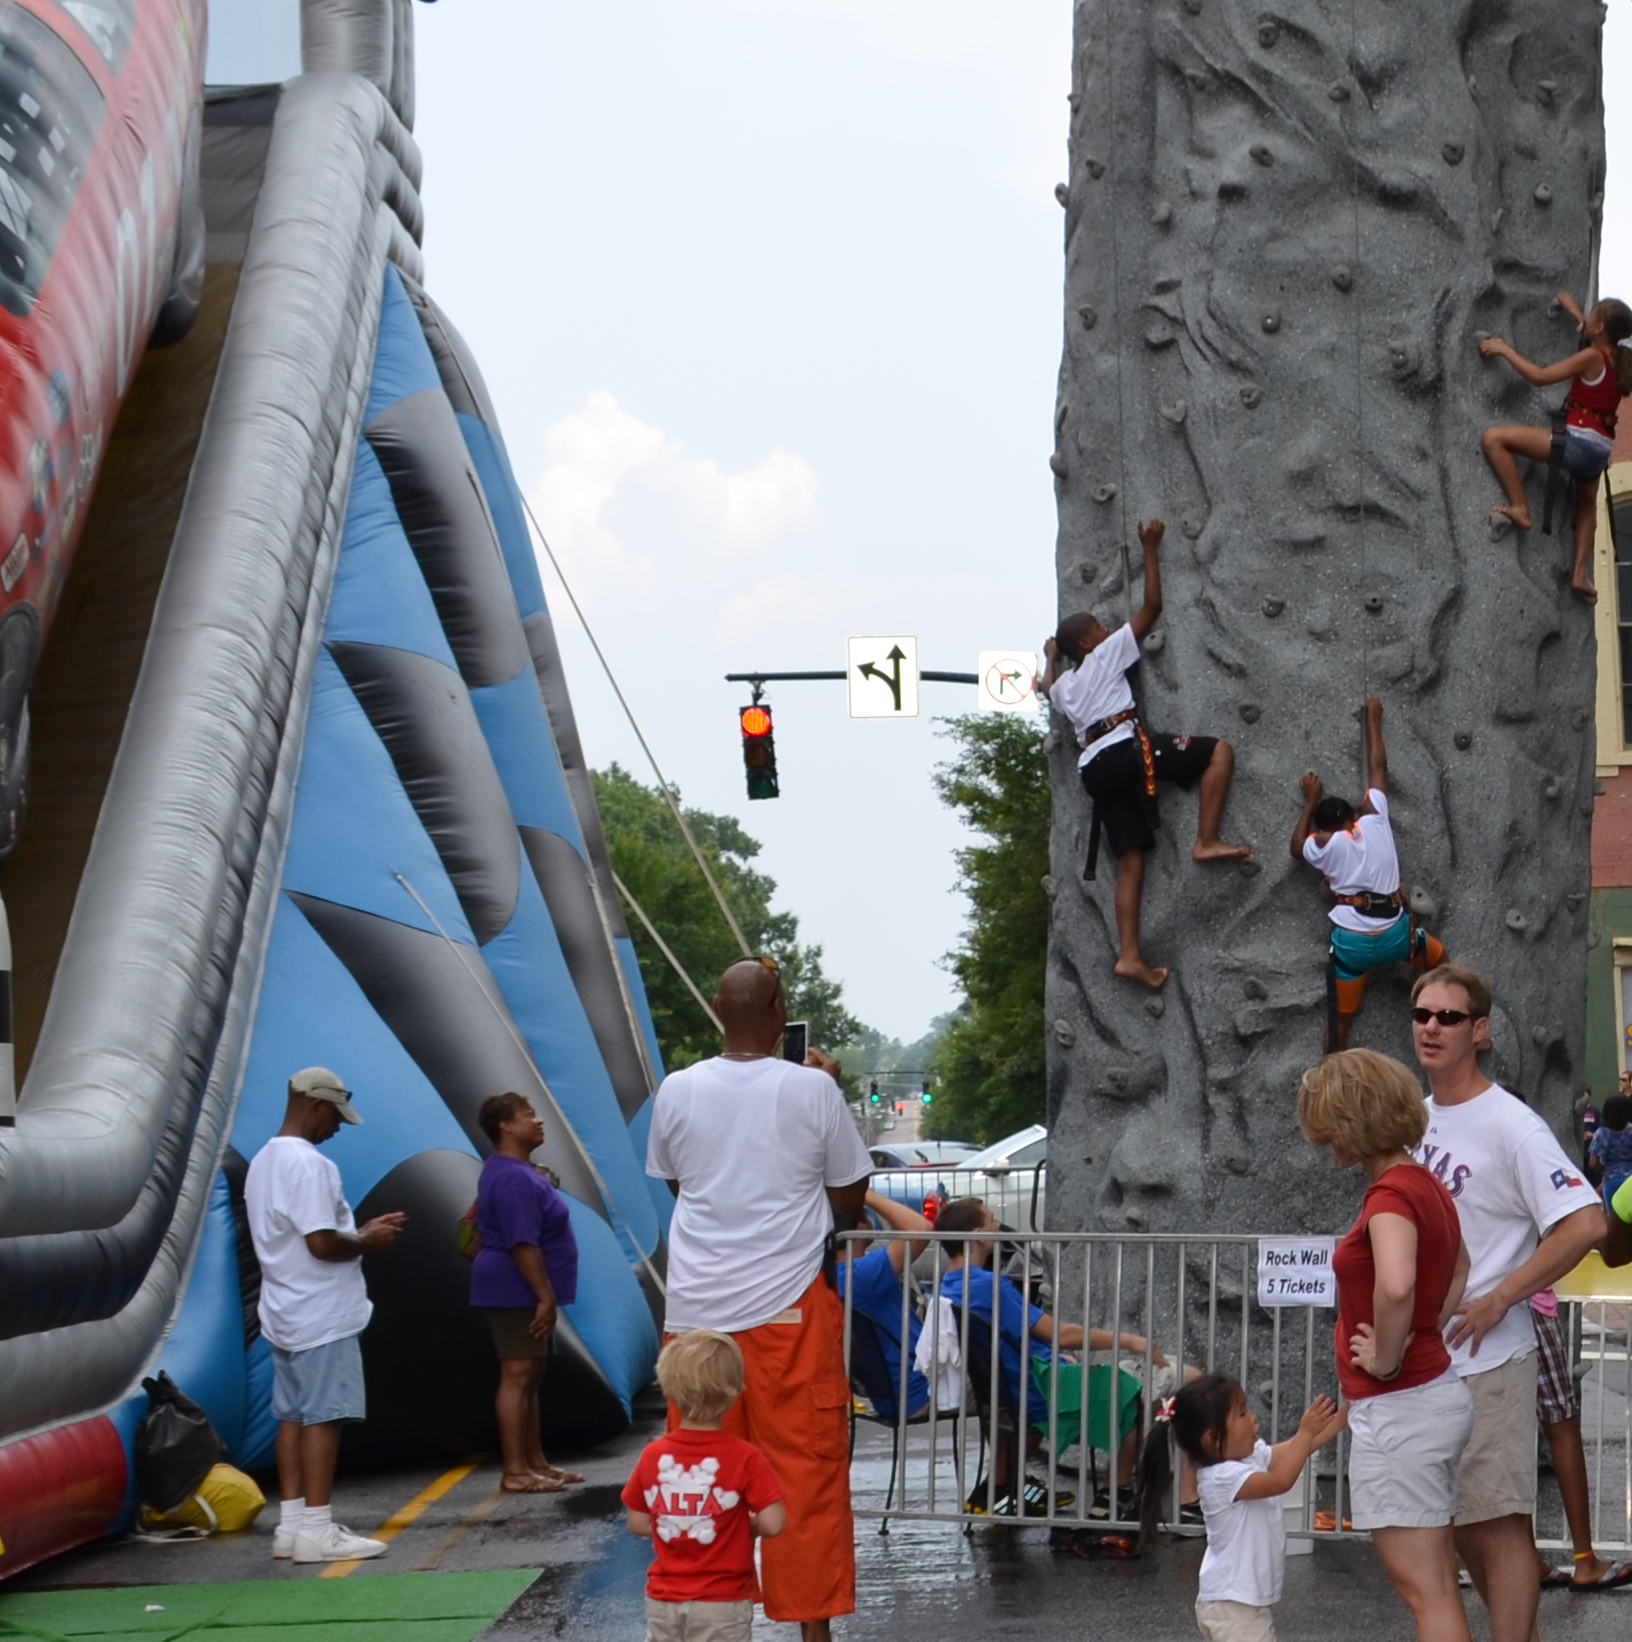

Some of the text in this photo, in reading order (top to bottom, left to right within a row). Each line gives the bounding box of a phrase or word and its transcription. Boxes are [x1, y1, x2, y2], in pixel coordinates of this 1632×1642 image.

[1265, 1249, 1328, 1266] Rock Wall
[1266, 1278, 1326, 1295] 5 Tickets
[651, 1491, 723, 1516] ALTA
